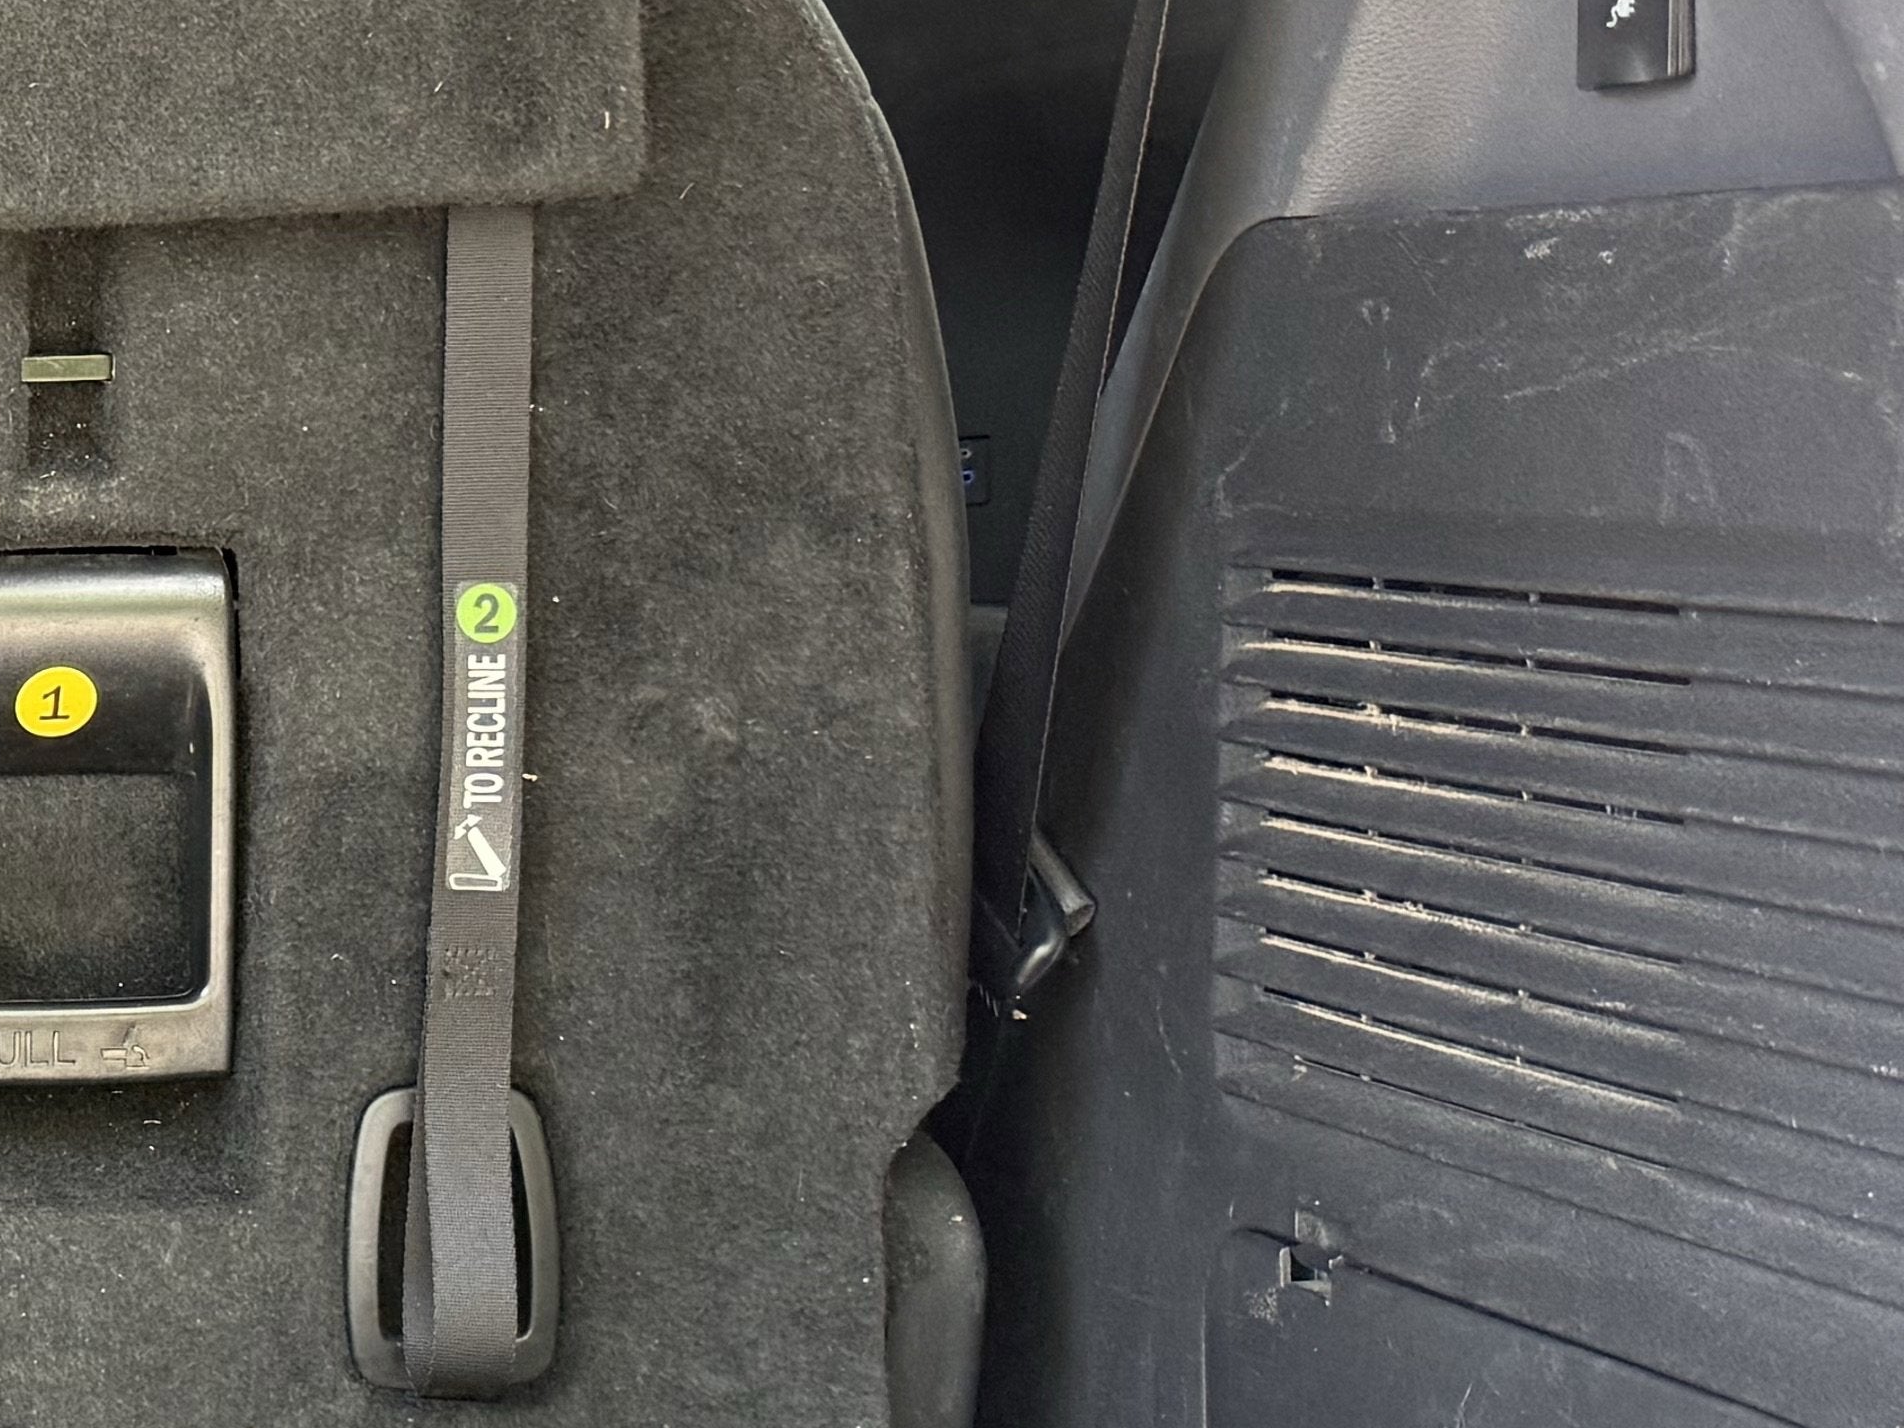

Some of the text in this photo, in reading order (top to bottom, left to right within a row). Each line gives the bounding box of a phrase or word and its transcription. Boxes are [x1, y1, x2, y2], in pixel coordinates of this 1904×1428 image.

[474, 593, 499, 634] 2
[38, 685, 71, 721] 1
[463, 653, 506, 809] TO RECLINE
